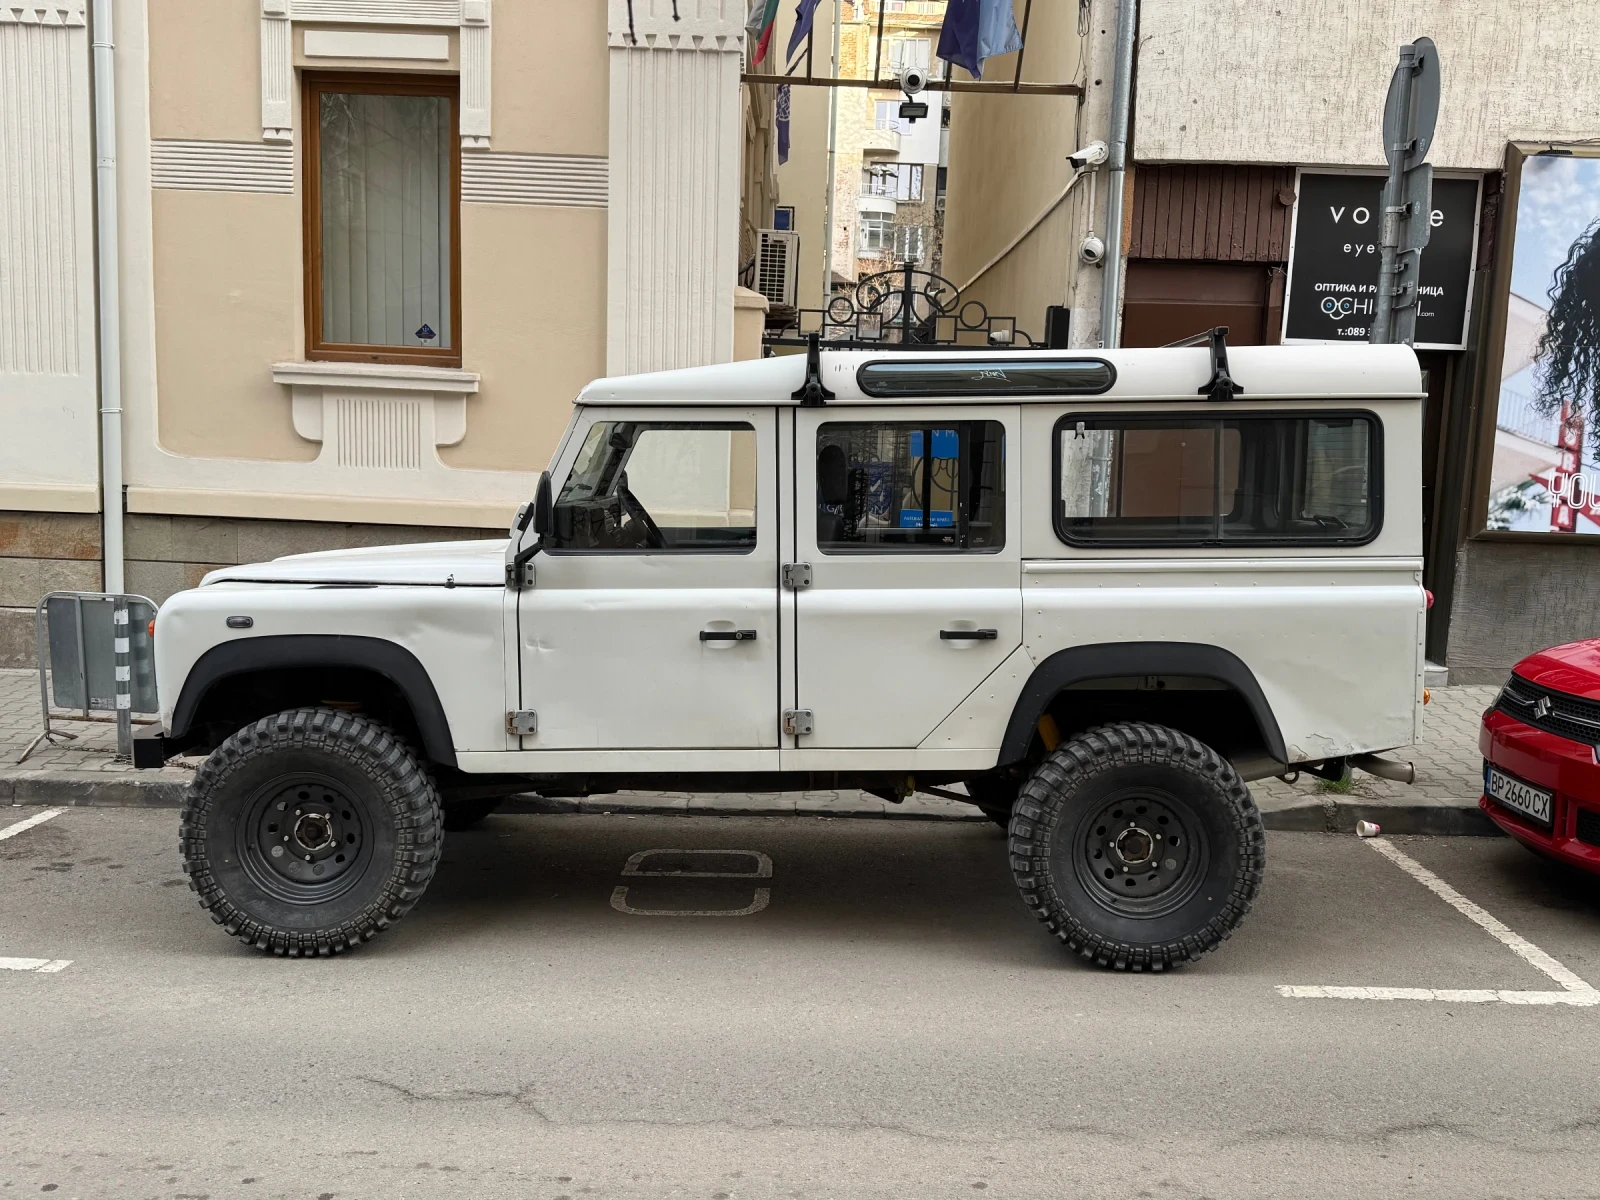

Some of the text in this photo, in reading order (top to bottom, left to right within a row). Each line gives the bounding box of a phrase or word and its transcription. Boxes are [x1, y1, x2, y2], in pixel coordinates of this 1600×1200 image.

[1329, 206, 1444, 227] voe
[1343, 243, 1375, 257] eye
[1314, 283, 1357, 293] ОПТИКА
[1358, 284, 1366, 293] И
[1505, 781, 1531, 809] 2660
